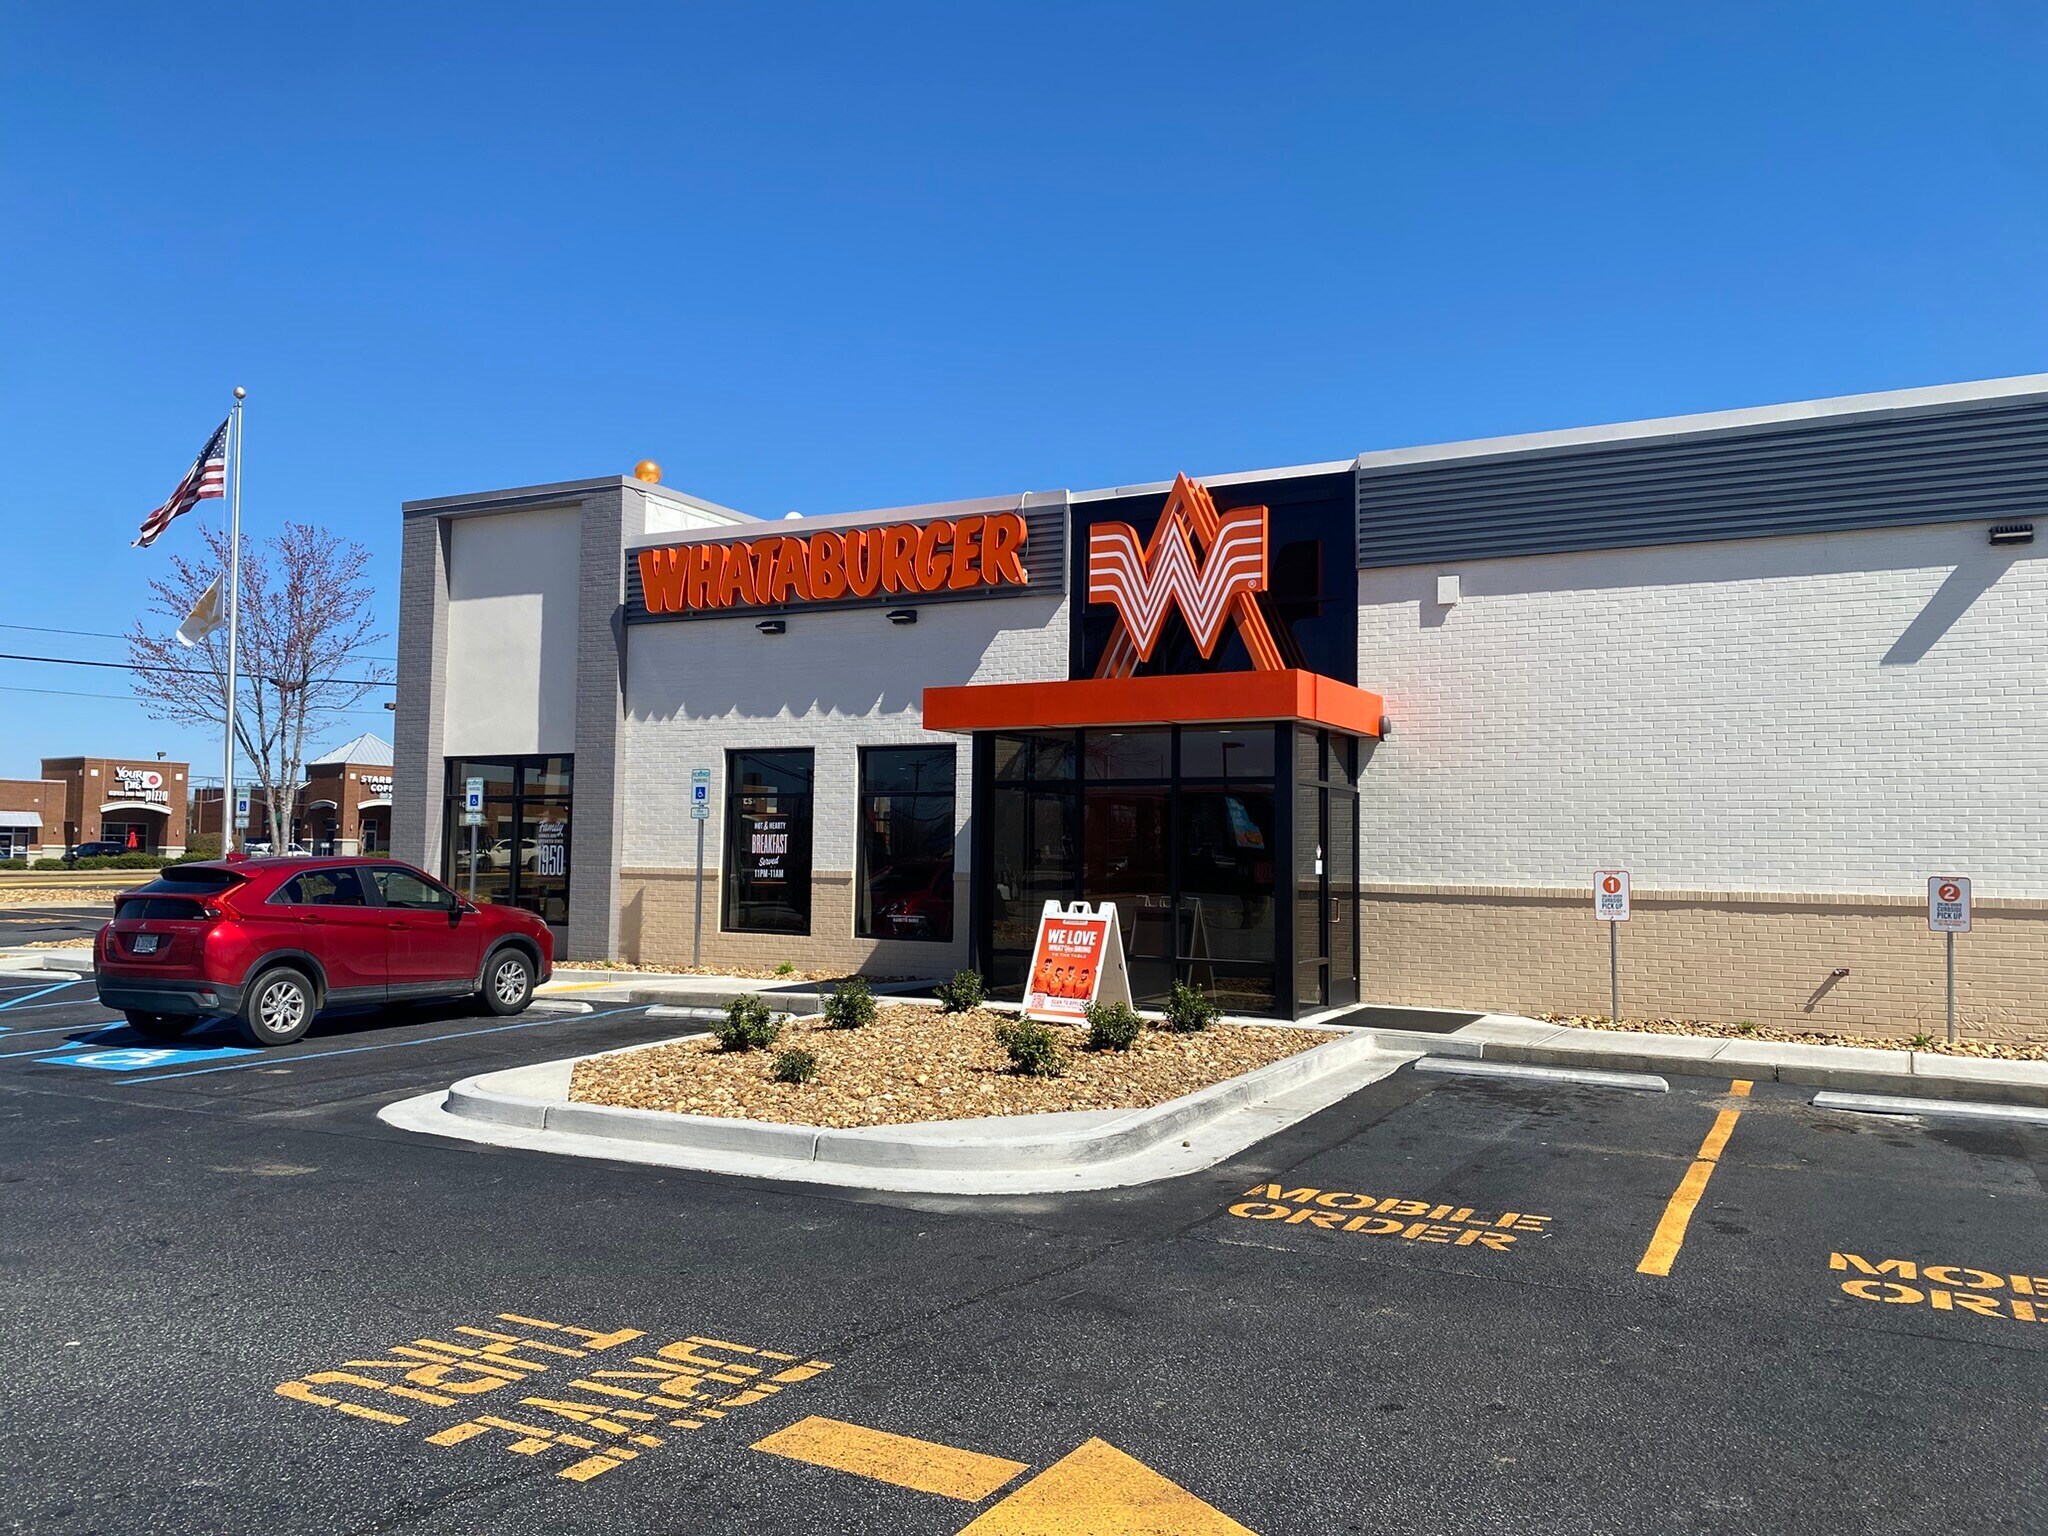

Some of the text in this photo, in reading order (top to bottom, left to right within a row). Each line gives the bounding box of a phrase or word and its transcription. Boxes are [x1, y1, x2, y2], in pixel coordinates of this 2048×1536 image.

[638, 511, 1029, 614] WHATABURGER
[538, 820, 564, 836] Family
[763, 820, 768, 830] &
[751, 833, 788, 854] BREAKFAST
[537, 844, 564, 876] 1950
[758, 855, 780, 867] Served
[754, 869, 784, 878] 11PM-11AM
[1608, 879, 1615, 892] 1
[1943, 886, 1956, 900] 2
[1953, 912, 1963, 920] UP
[1047, 928, 1098, 946] WE LOVE
[1048, 944, 1064, 952] WHAT
[1074, 945, 1092, 954] BRING
[1243, 1183, 1552, 1232] MOBILE
[1228, 1203, 1518, 1251] ORDER
[272, 1312, 649, 1426] THRU
